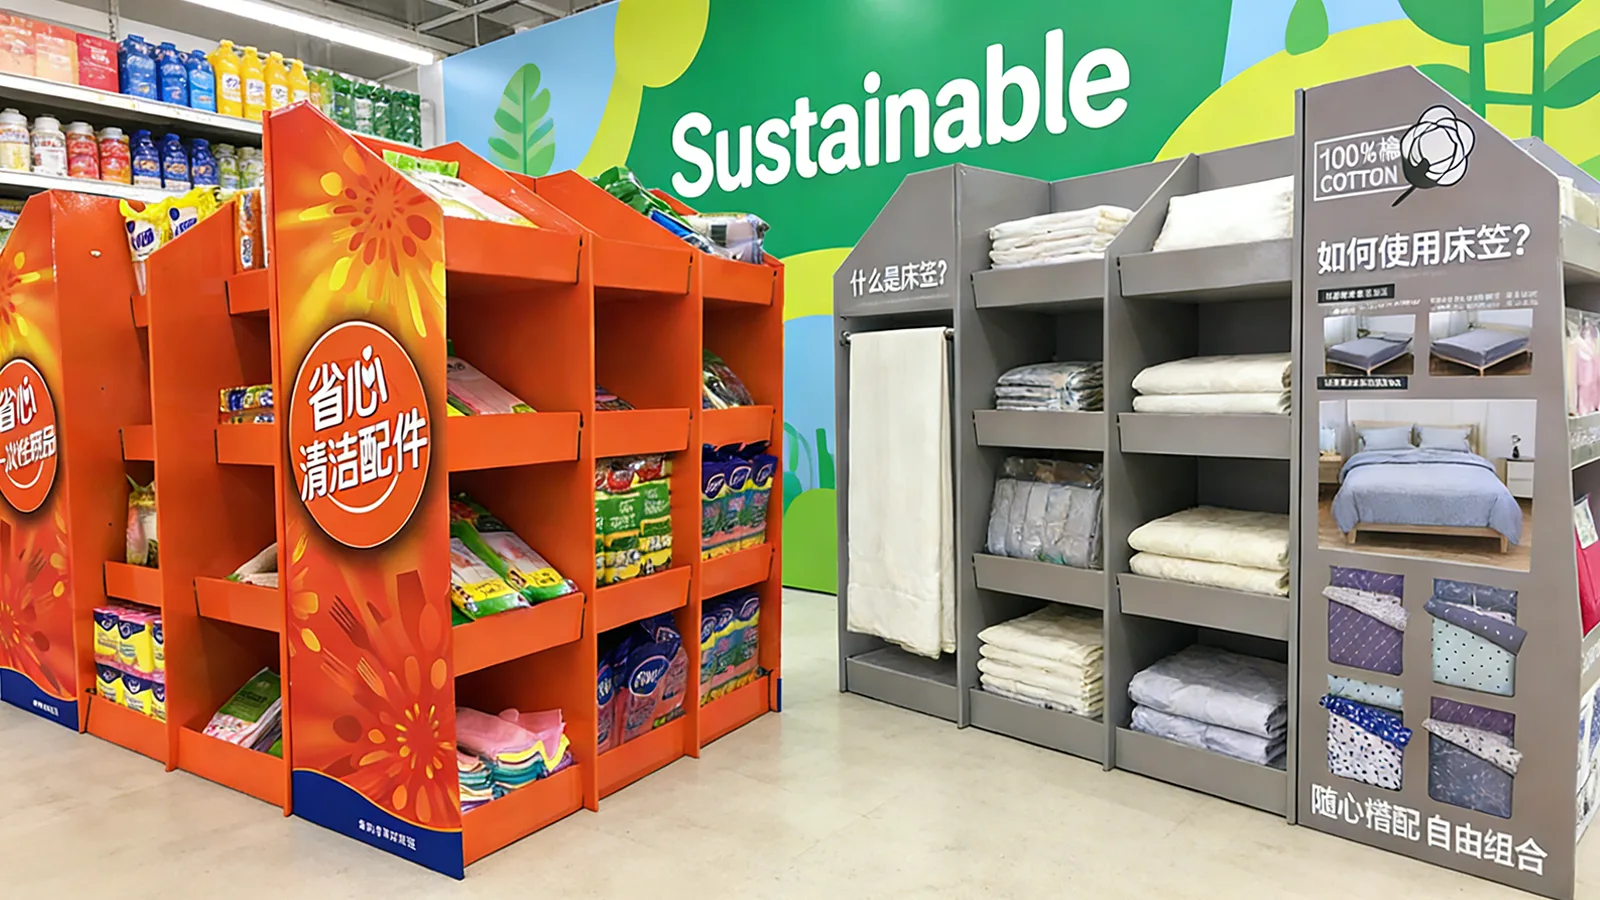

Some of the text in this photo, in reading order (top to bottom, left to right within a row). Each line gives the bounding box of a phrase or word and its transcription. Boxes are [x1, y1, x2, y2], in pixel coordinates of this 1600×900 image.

[670, 27, 1131, 198] Sustainable
[1320, 165, 1398, 193] COTTON
[308, 345, 388, 432] 省心
[299, 407, 429, 501] 清洁配件
[1427, 814, 1548, 876] 自由组合
